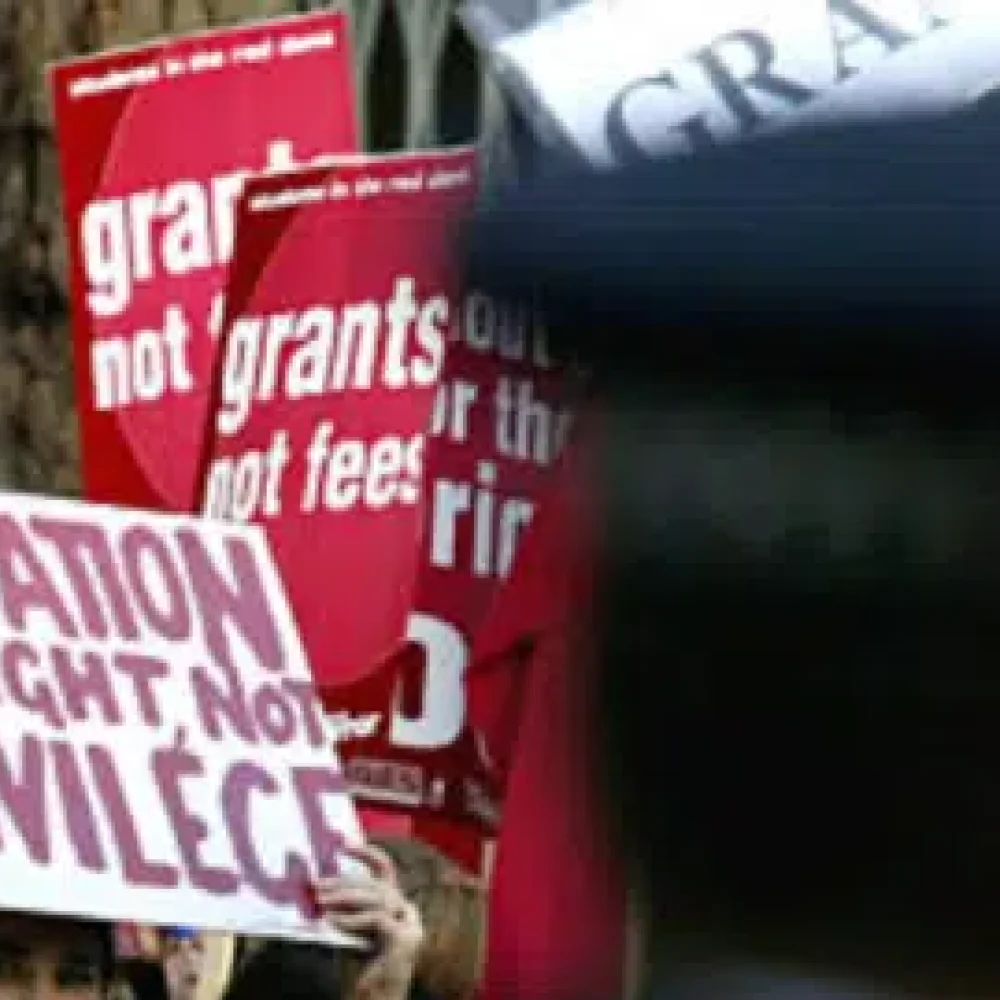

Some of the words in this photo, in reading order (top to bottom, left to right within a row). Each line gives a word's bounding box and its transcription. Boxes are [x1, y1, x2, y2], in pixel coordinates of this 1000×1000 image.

[603, 0, 955, 163] GRA
[92, 305, 195, 411] not
[216, 276, 450, 436] grants
[205, 430, 290, 522] not
[188, 664, 323, 747] NOT
